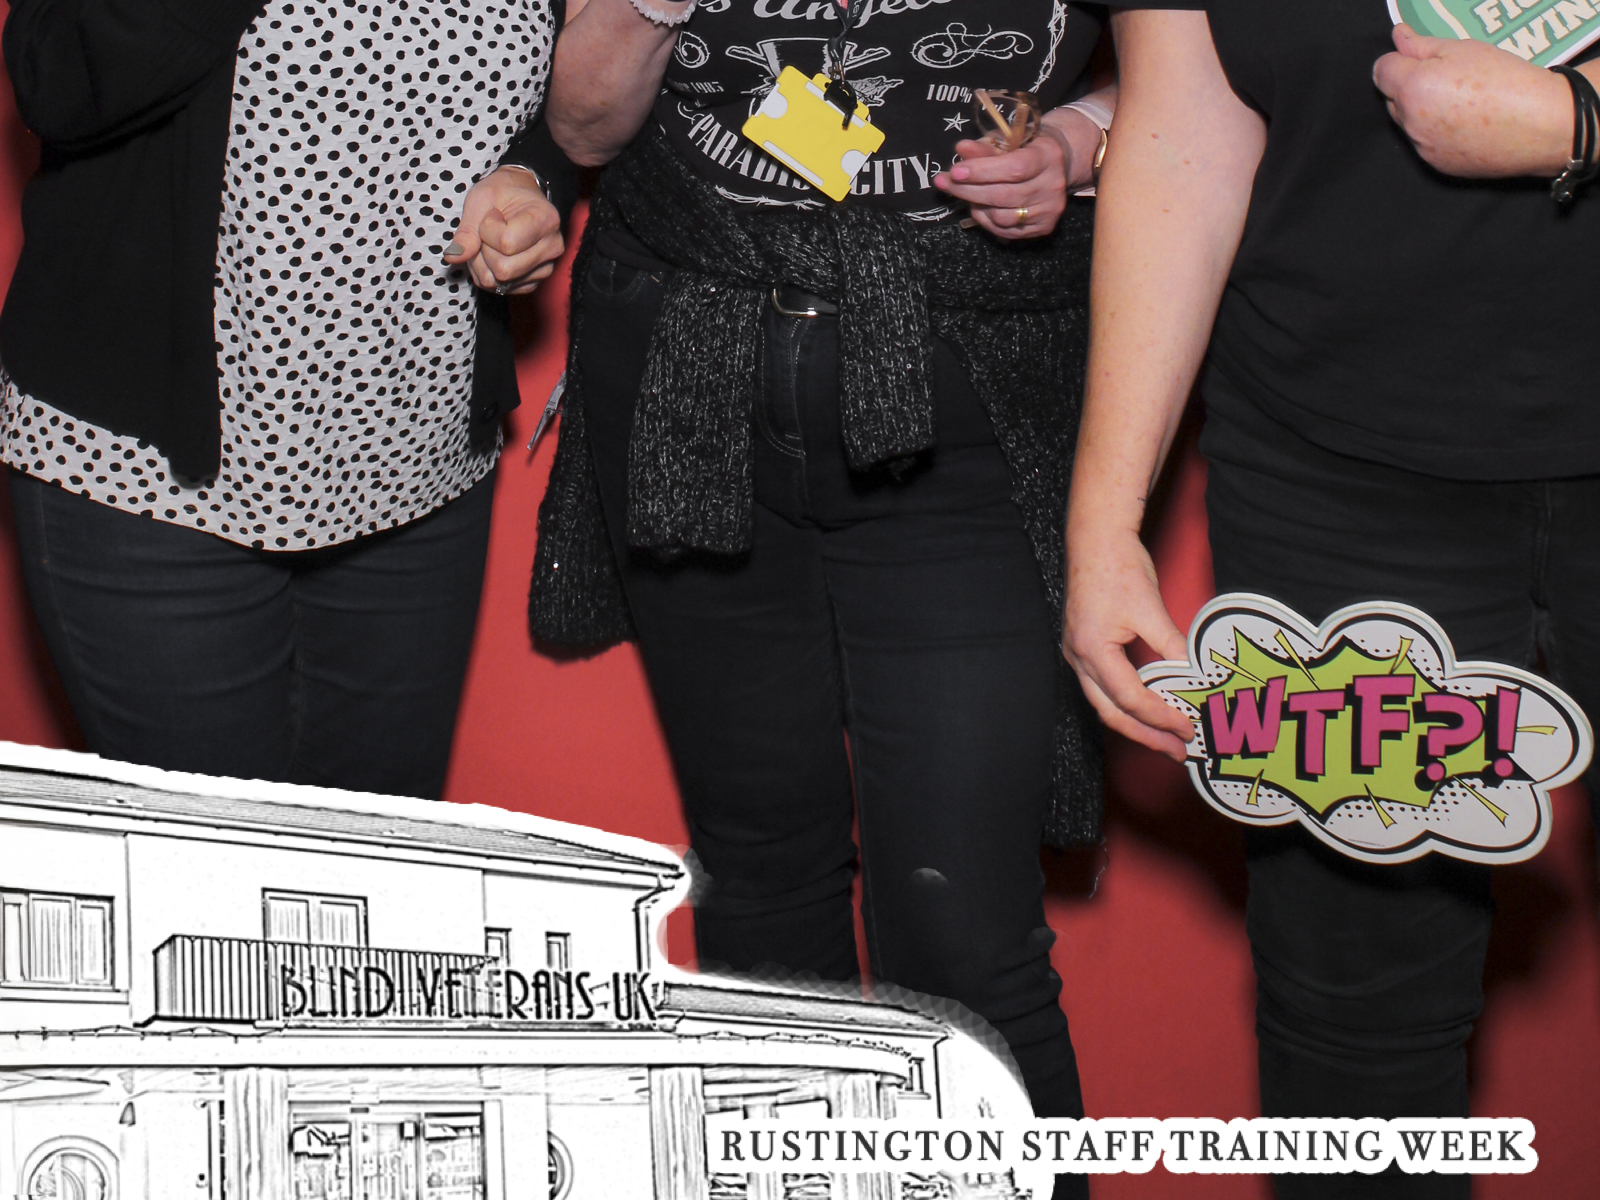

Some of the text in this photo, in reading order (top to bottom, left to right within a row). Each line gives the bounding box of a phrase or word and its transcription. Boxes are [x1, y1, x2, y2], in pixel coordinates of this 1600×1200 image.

[926, 83, 973, 104] 100%
[850, 153, 932, 196] CITY
[1202, 674, 1522, 790] WTF?!
